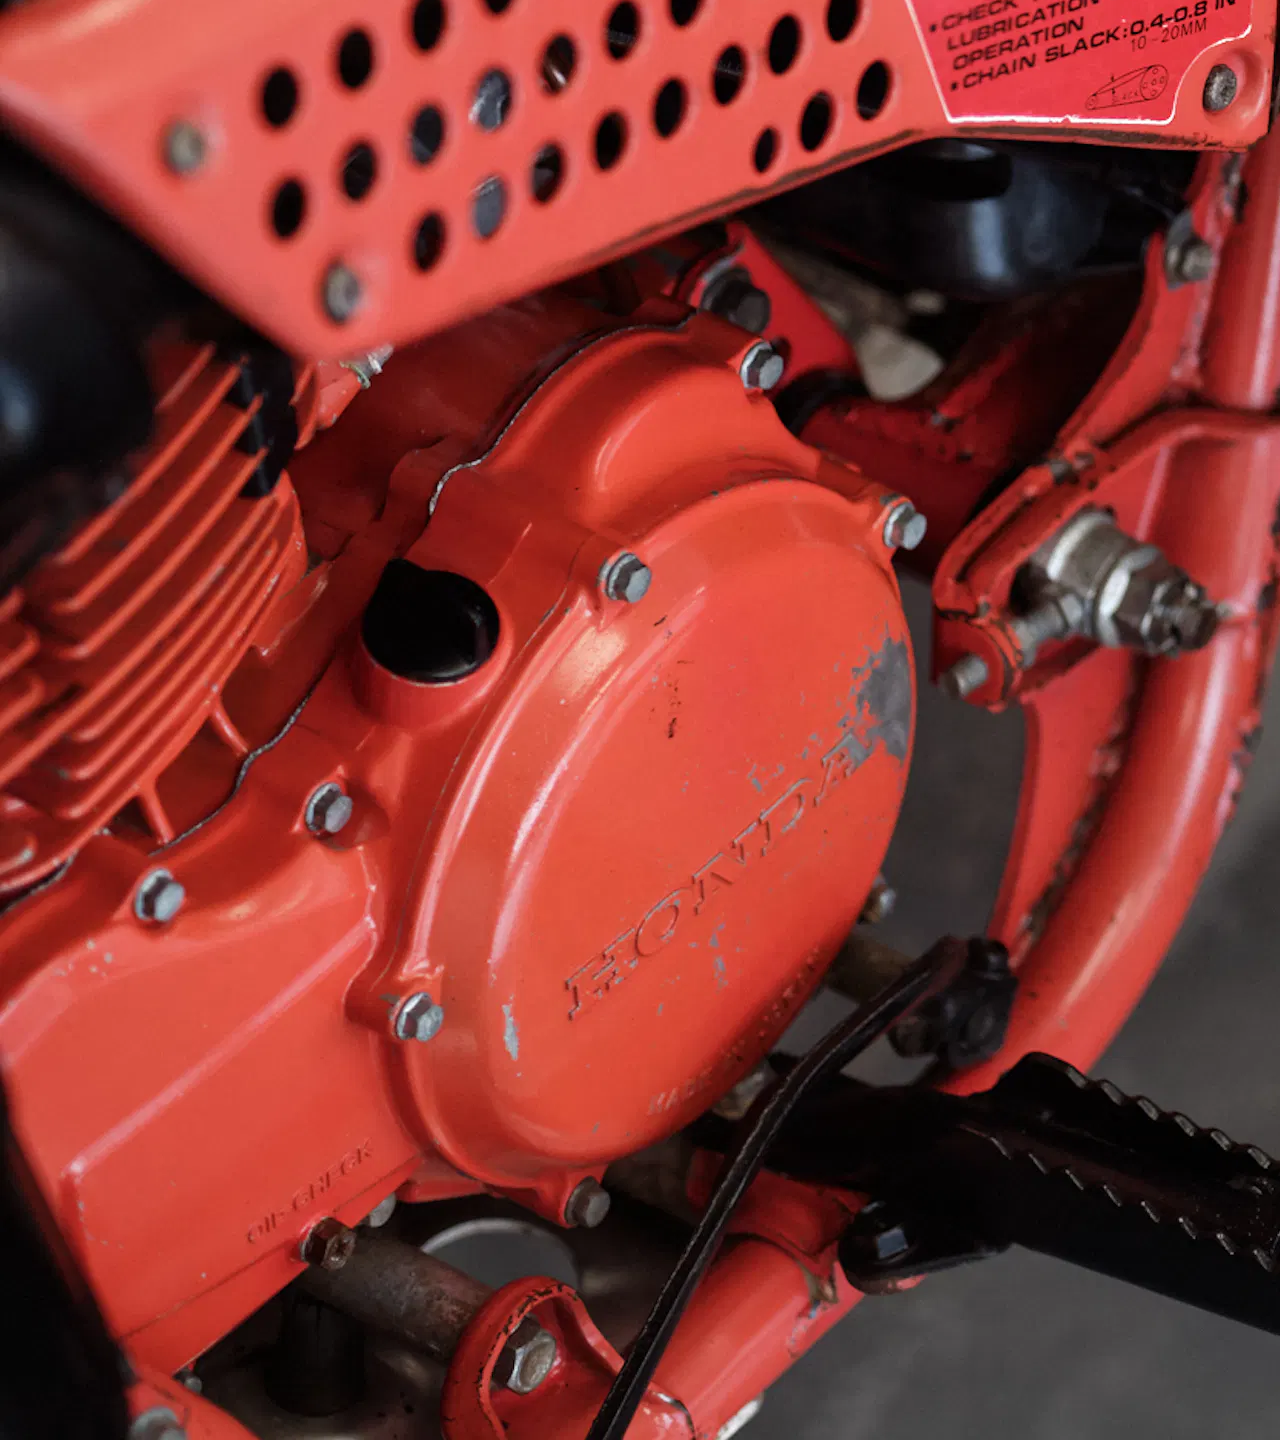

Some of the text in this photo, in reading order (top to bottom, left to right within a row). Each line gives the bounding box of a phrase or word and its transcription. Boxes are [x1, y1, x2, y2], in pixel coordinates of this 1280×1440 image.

[952, 16, 1085, 71] OPERATION
[961, 53, 1037, 90] CHAIN
[564, 730, 872, 1021] HONDA
